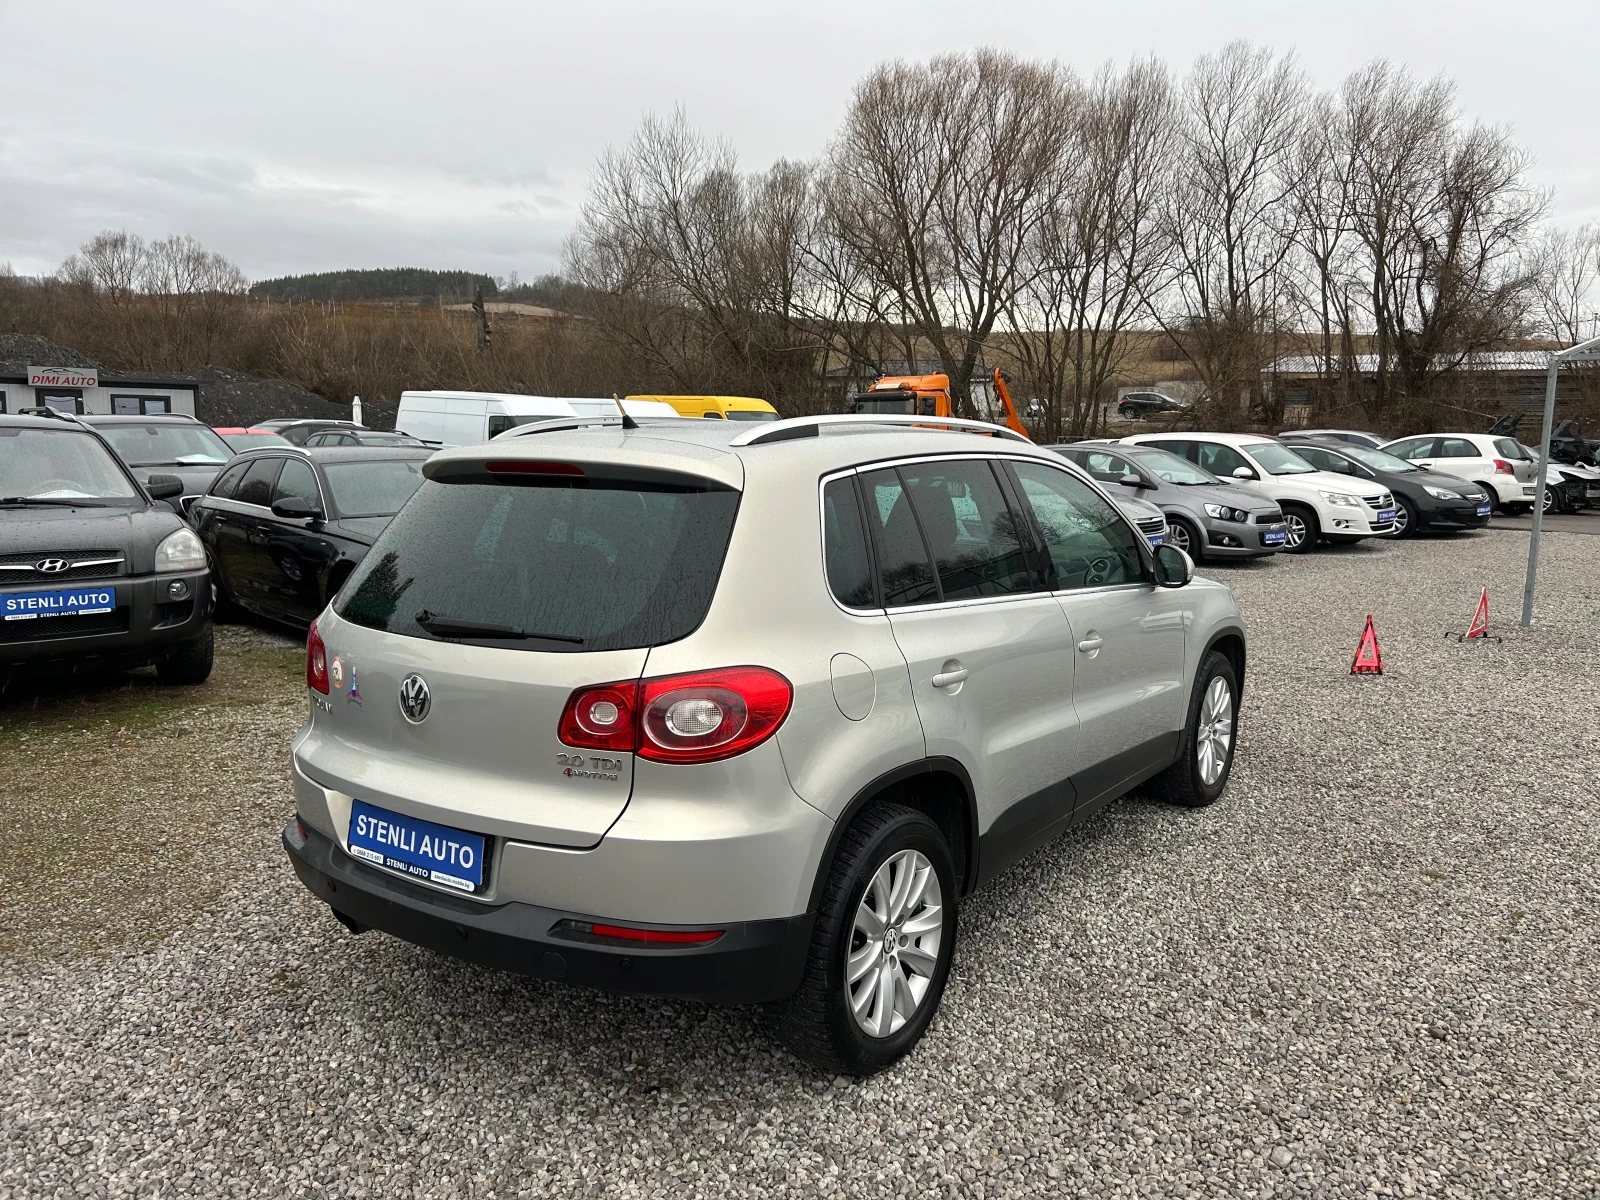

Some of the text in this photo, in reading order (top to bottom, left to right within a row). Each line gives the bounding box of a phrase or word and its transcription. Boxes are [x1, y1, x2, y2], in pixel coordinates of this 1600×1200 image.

[31, 375, 96, 386] DIMI AUTO
[6, 593, 110, 610] STENLI AUTO
[589, 756, 622, 771] TDI
[563, 767, 618, 781] 4MOTION
[356, 814, 474, 869] STENLI AUTO
[386, 858, 428, 878] STENLI AUTO
